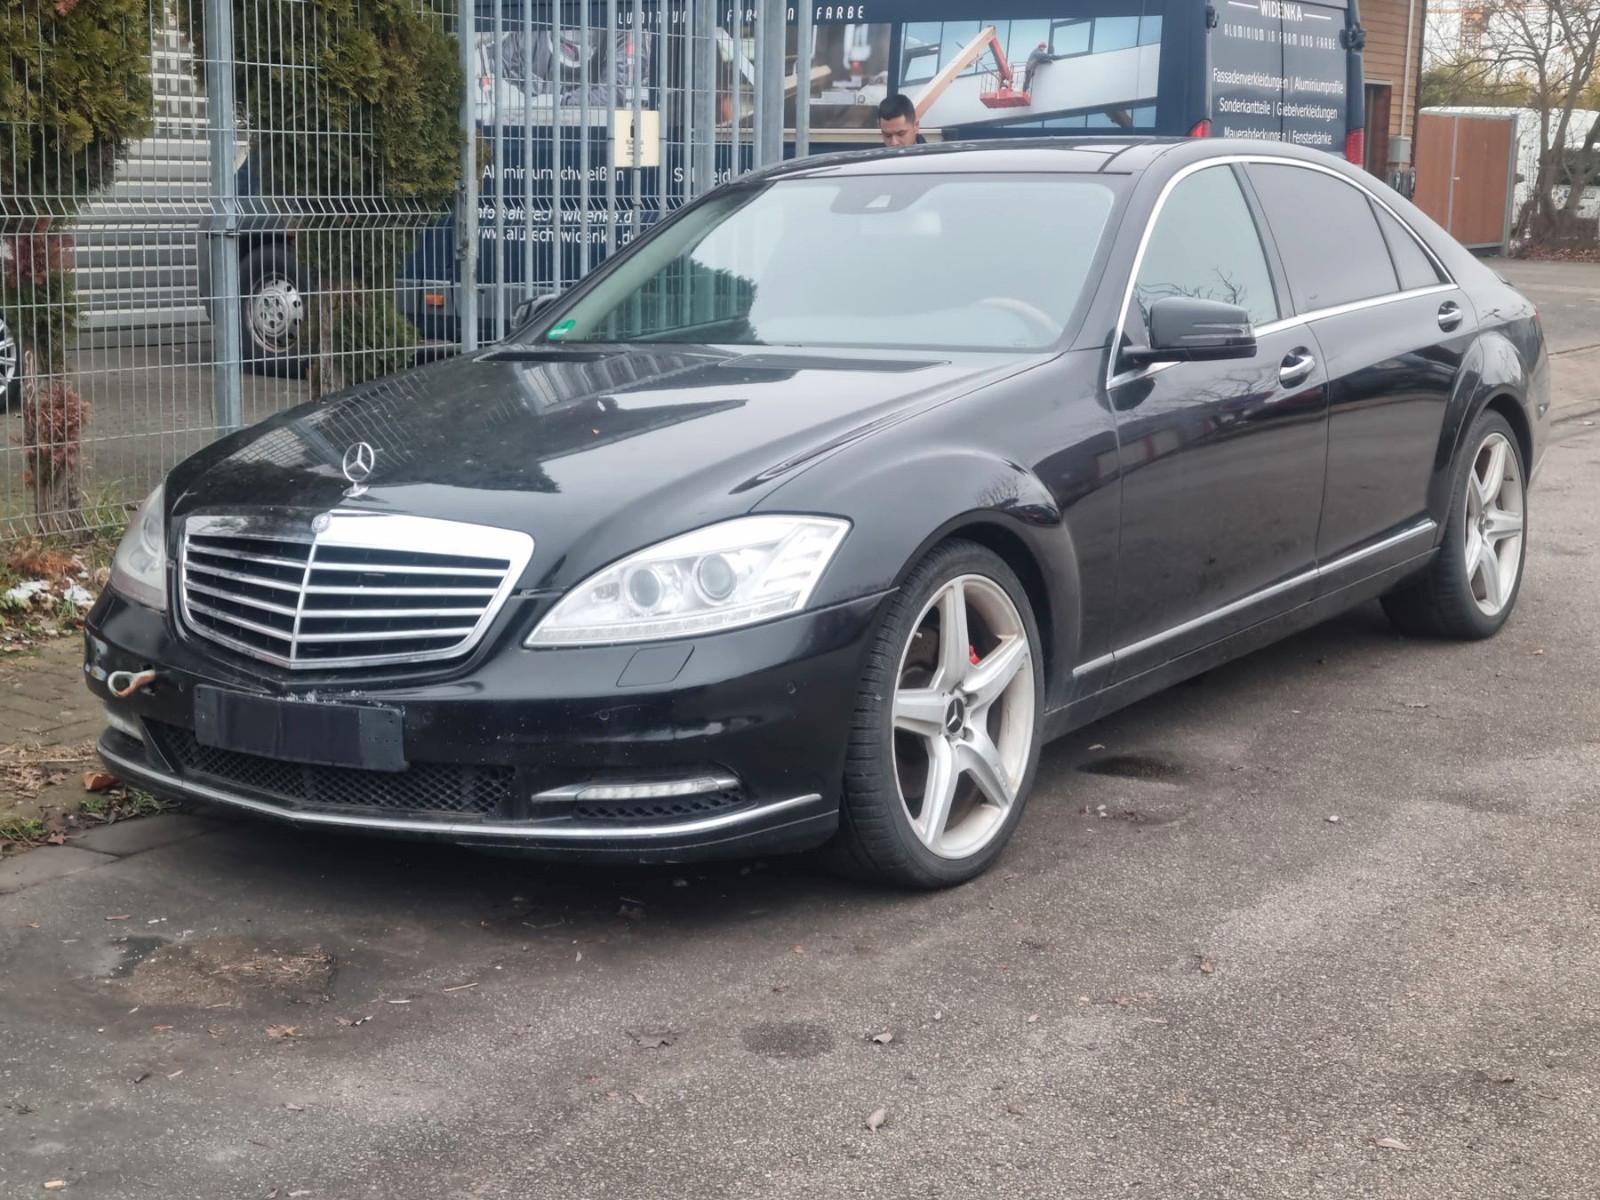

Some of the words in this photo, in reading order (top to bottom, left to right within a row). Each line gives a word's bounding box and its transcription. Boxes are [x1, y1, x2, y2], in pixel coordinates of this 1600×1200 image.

[816, 5, 864, 20] FARBE
[1260, 0, 1302, 21] WIDENKA
[1213, 67, 1288, 91] Fassadenverkleidungen
[1295, 76, 1343, 95] Aluminiumprofile
[1219, 97, 1271, 115] Sonderkantteile
[1277, 102, 1338, 122] Giebelverkleidungen
[1293, 130, 1332, 145] Fensterbänke
